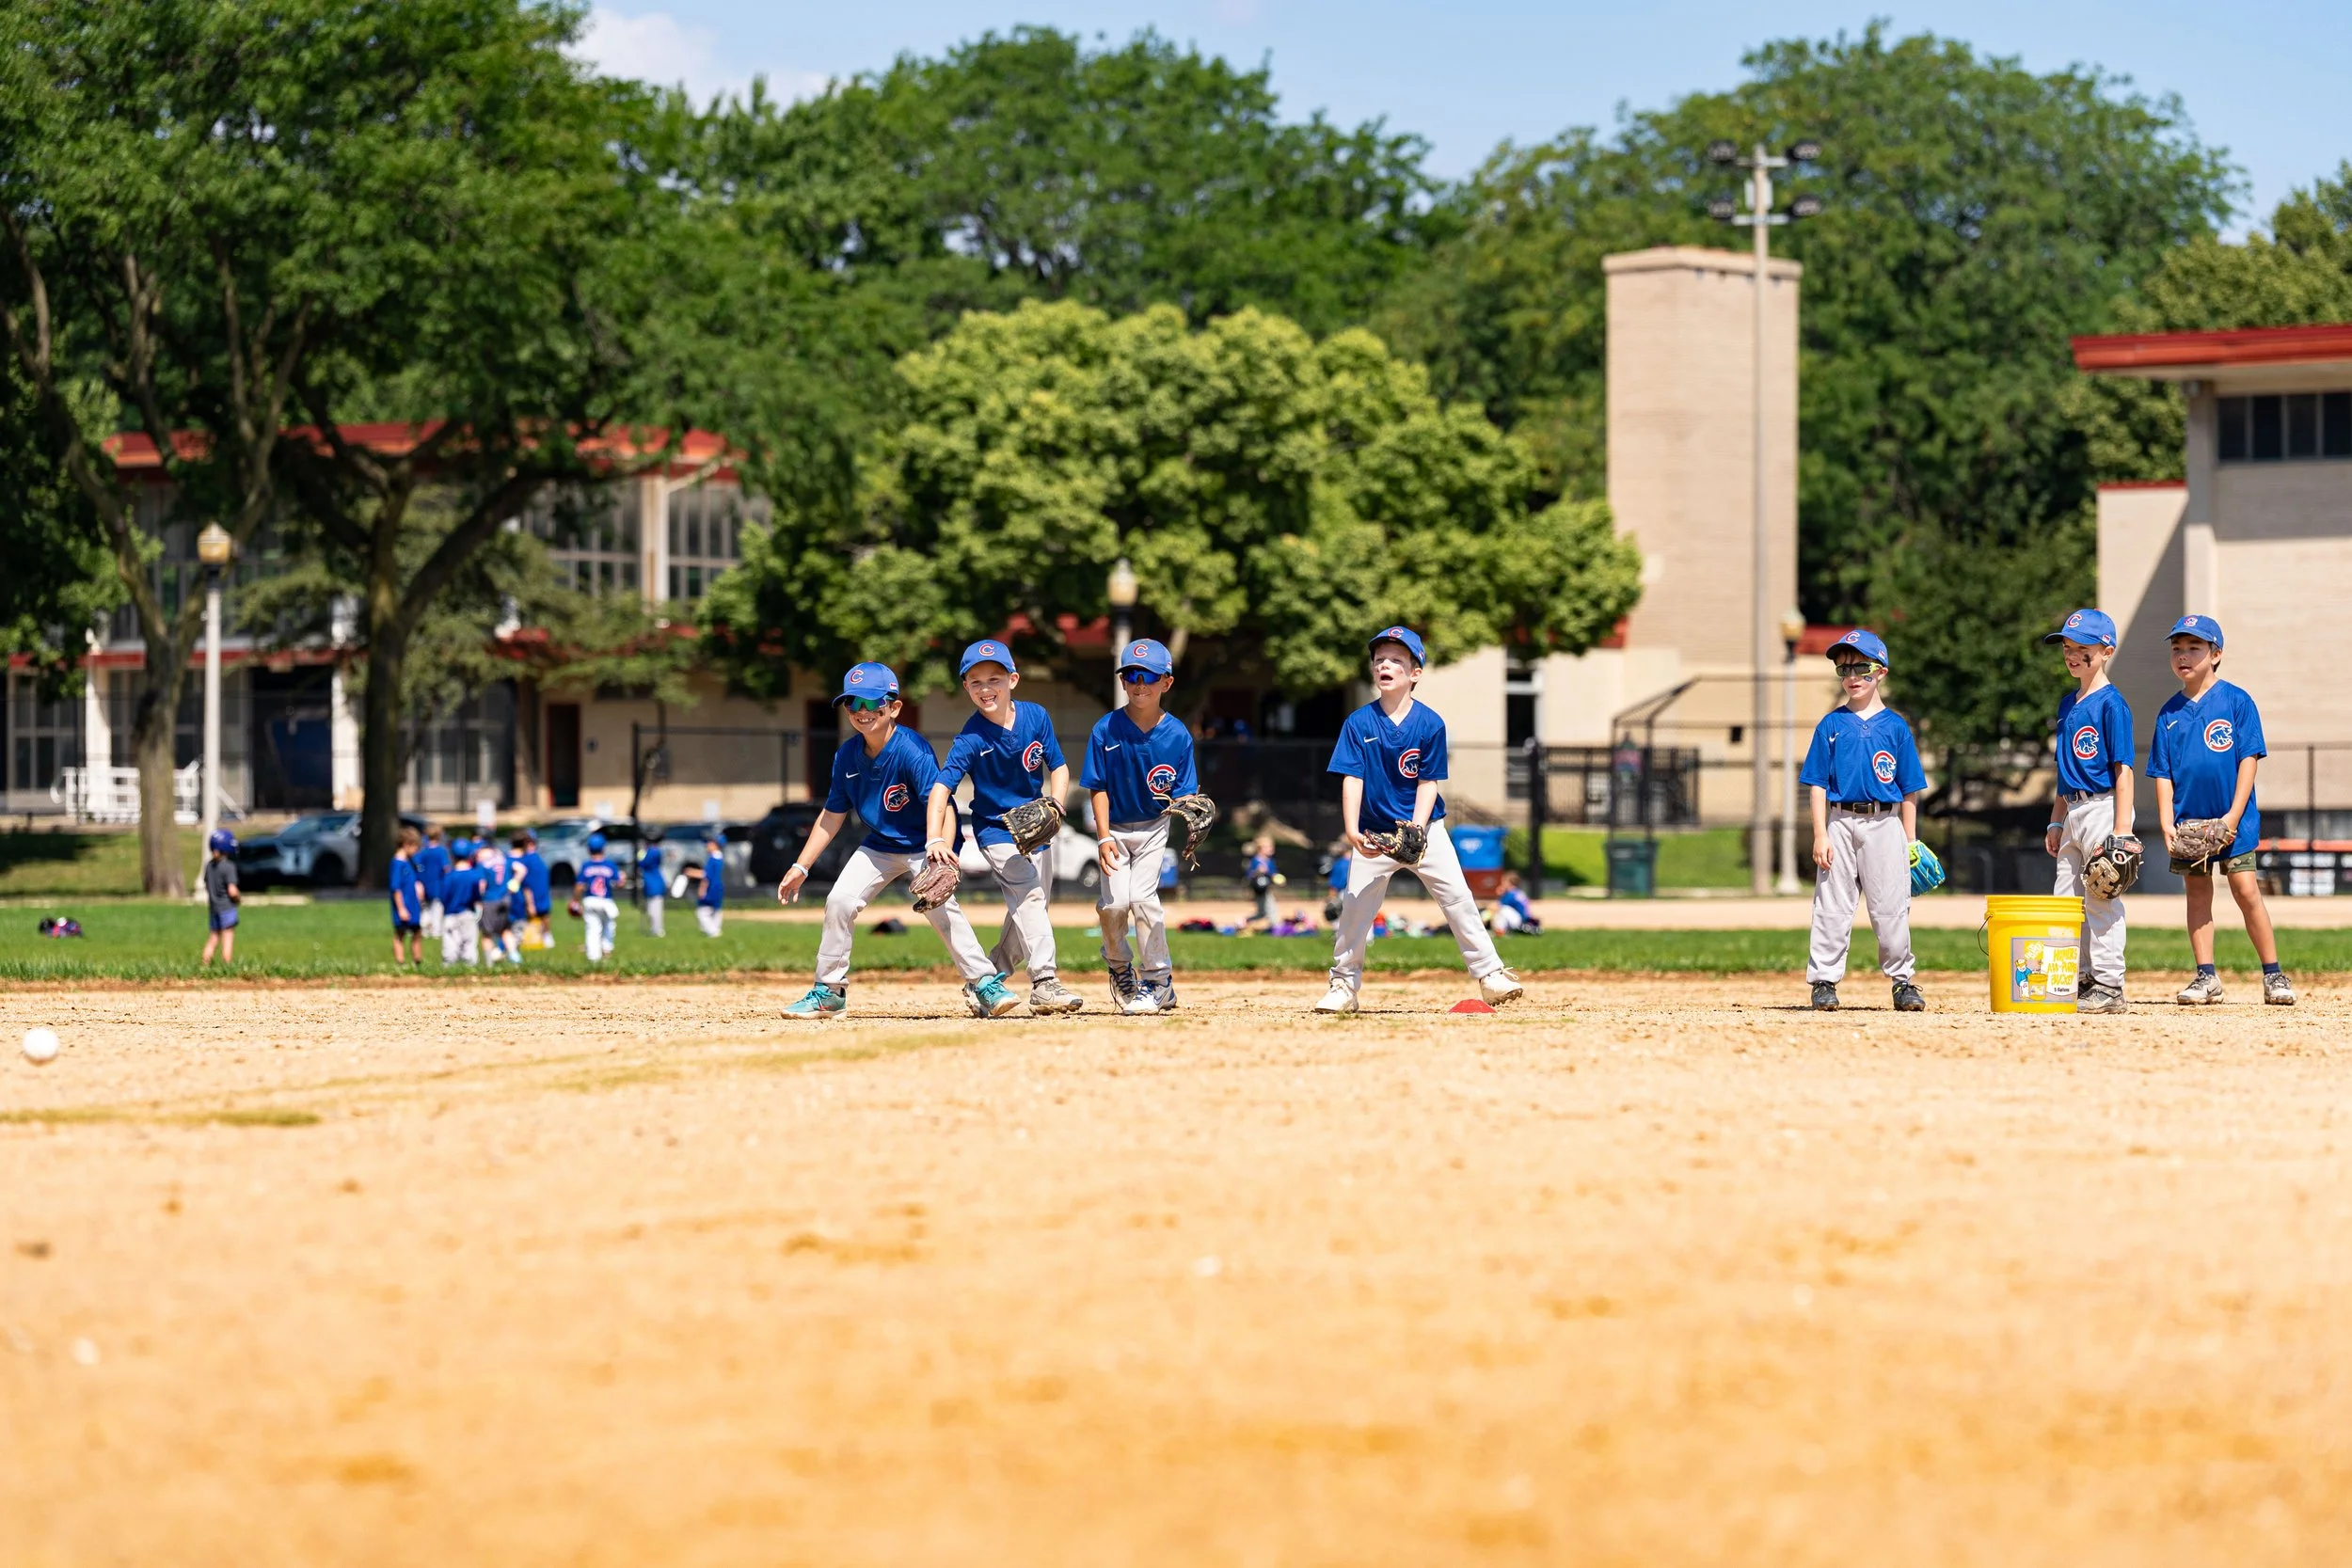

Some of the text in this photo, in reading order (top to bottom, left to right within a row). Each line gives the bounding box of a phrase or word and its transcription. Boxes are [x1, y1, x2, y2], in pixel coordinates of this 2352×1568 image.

[2067, 613, 2083, 628] C
[1388, 627, 1404, 639] C
[1845, 631, 1861, 644] C
[978, 643, 995, 657] C
[1133, 644, 1149, 658] C
[850, 670, 865, 685] C
[2073, 725, 2098, 760] C
[2204, 719, 2234, 752] C
[1872, 751, 1896, 784] C
[1147, 764, 1176, 795] C
